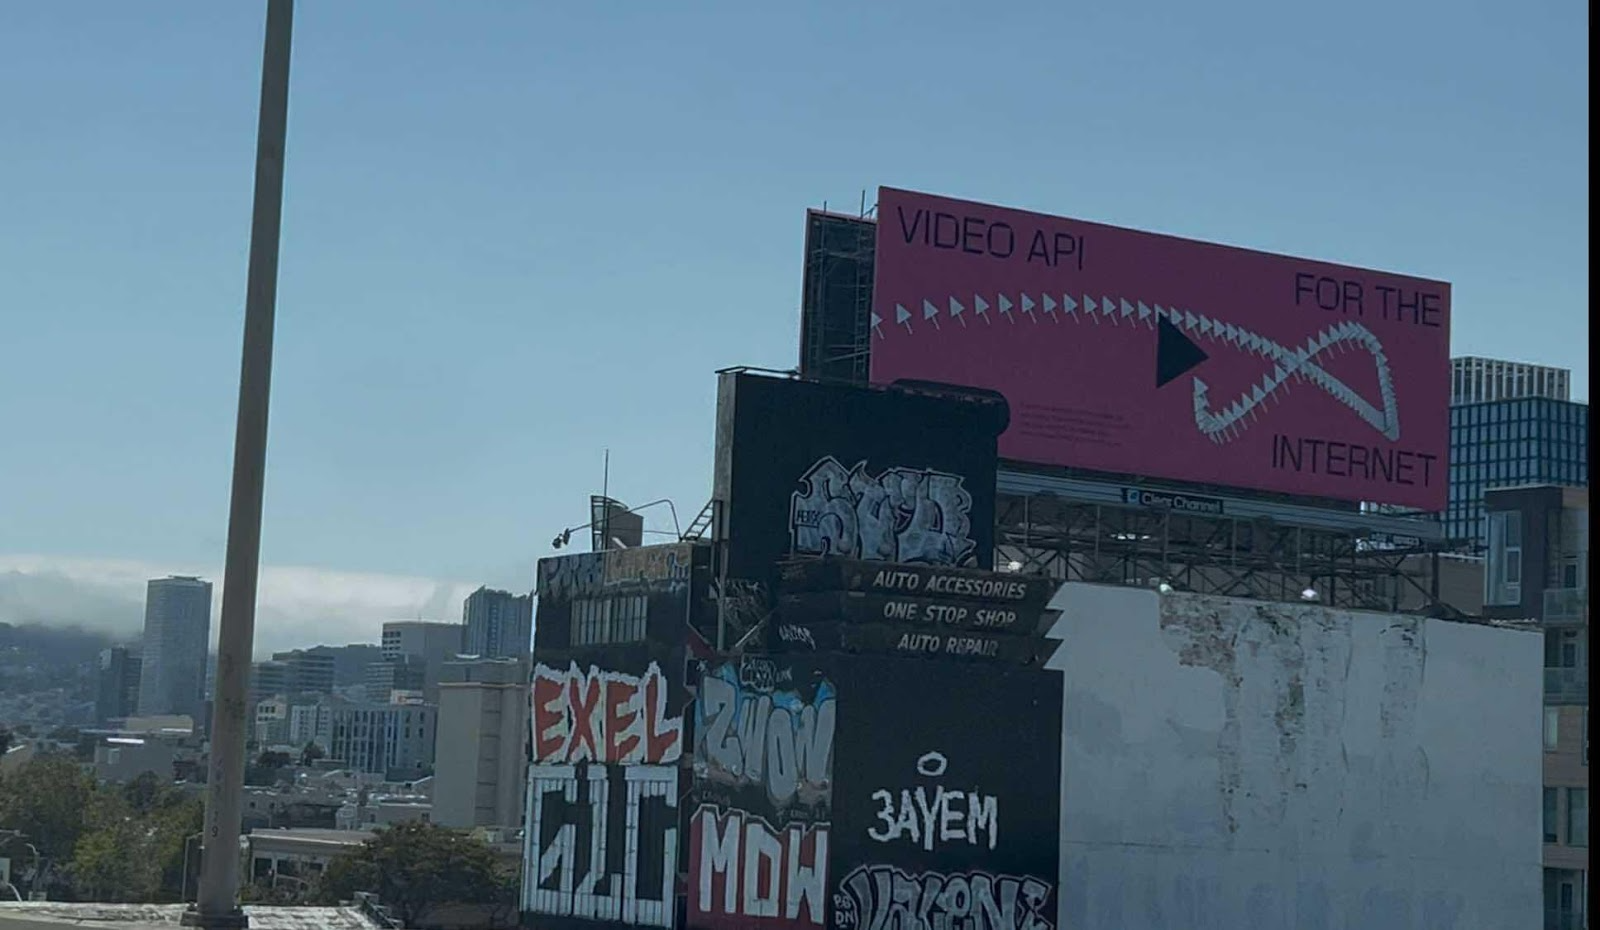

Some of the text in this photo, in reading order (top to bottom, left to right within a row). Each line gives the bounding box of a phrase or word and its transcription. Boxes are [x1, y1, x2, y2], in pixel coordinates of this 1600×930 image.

[898, 205, 1084, 271] VIDEO API
[1296, 272, 1440, 327] FOR THE
[1272, 433, 1437, 488] INTERNET
[873, 571, 1027, 599] AUTO ACCESSORIES
[883, 602, 1016, 628] ONE STOP SHOP
[897, 634, 999, 657] AUTO REPAIR
[532, 662, 683, 764] EXEL
